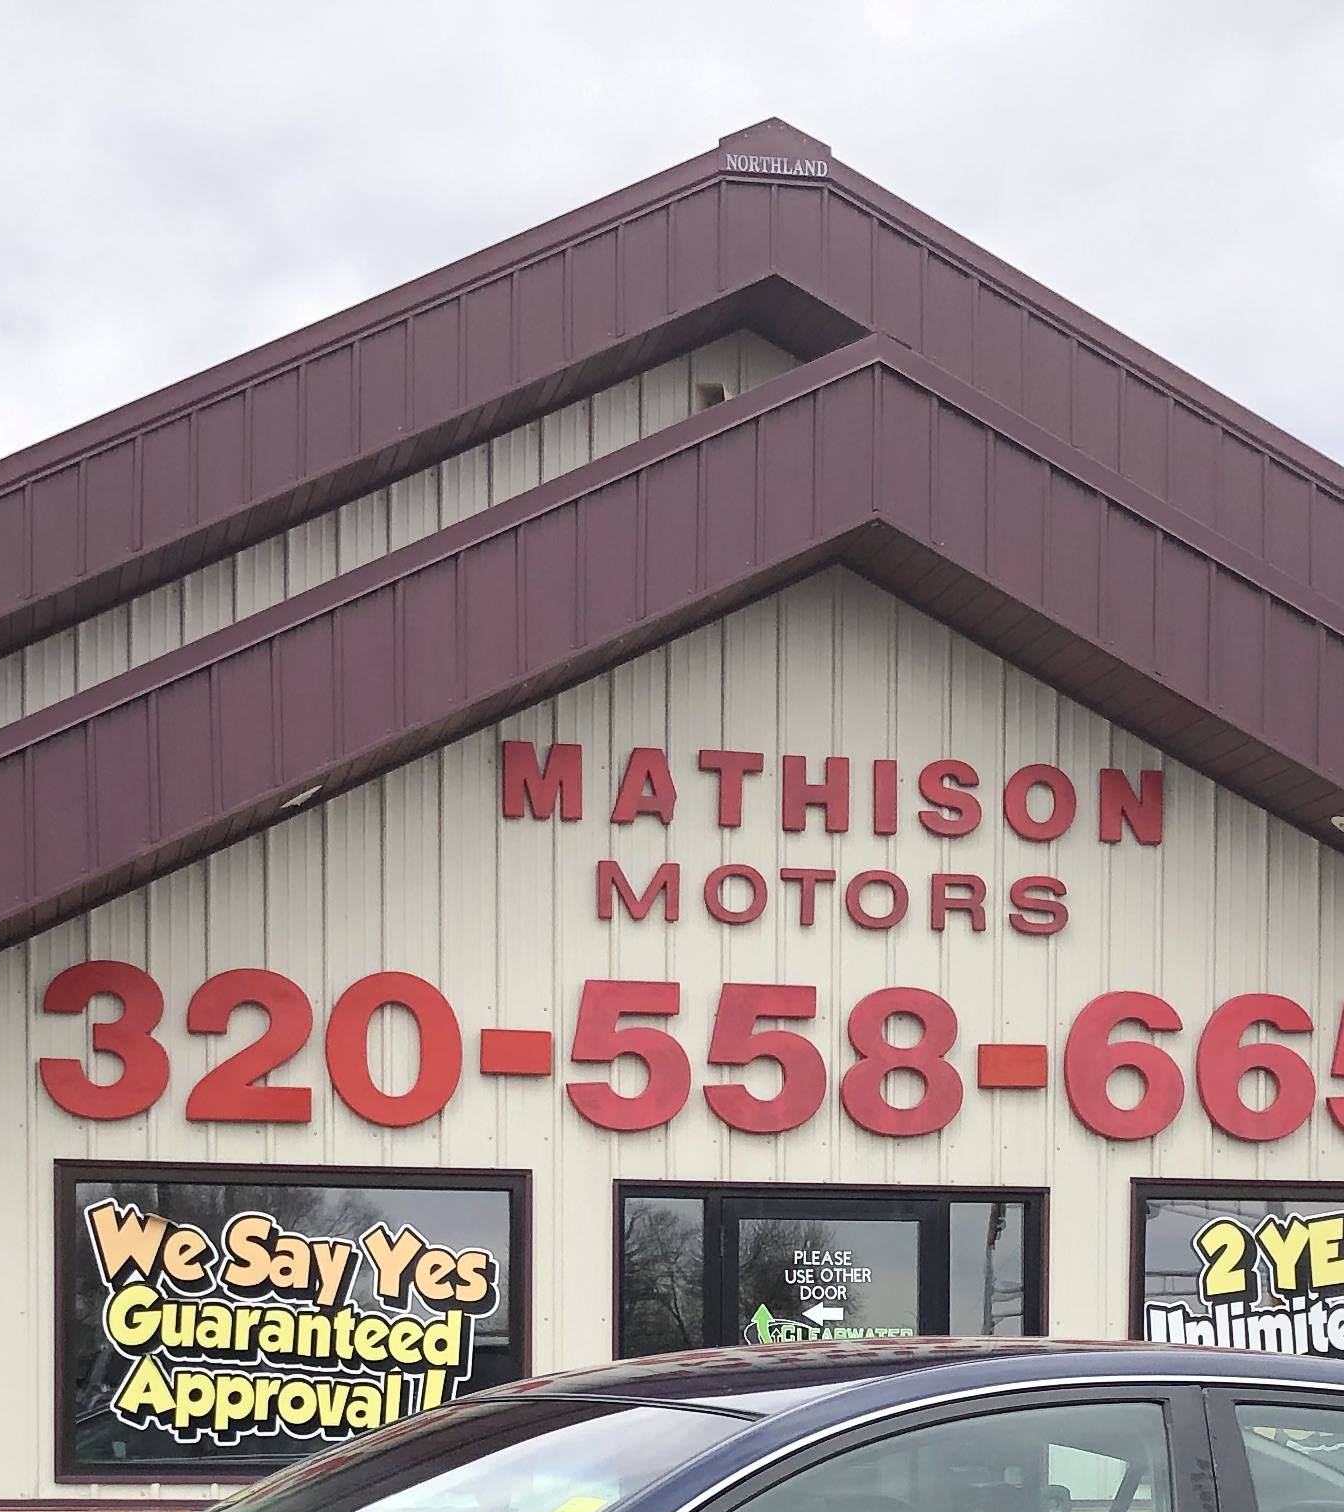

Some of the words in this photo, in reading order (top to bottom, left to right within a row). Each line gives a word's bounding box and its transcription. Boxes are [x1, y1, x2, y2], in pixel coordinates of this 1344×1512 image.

[726, 154, 828, 177] NORTHLAND
[503, 740, 1164, 845] MATHISON
[596, 859, 1069, 936] MOTORS
[88, 1203, 209, 1283] We
[224, 1216, 354, 1306] Say
[362, 1226, 490, 1303] Yes
[785, 1269, 815, 1284] USE
[820, 1267, 872, 1283] OTHER
[794, 1250, 852, 1266] PLEASE
[1201, 1222, 1250, 1297] 2
[108, 1283, 463, 1366] Guaranteed
[800, 1285, 848, 1301] DOOR
